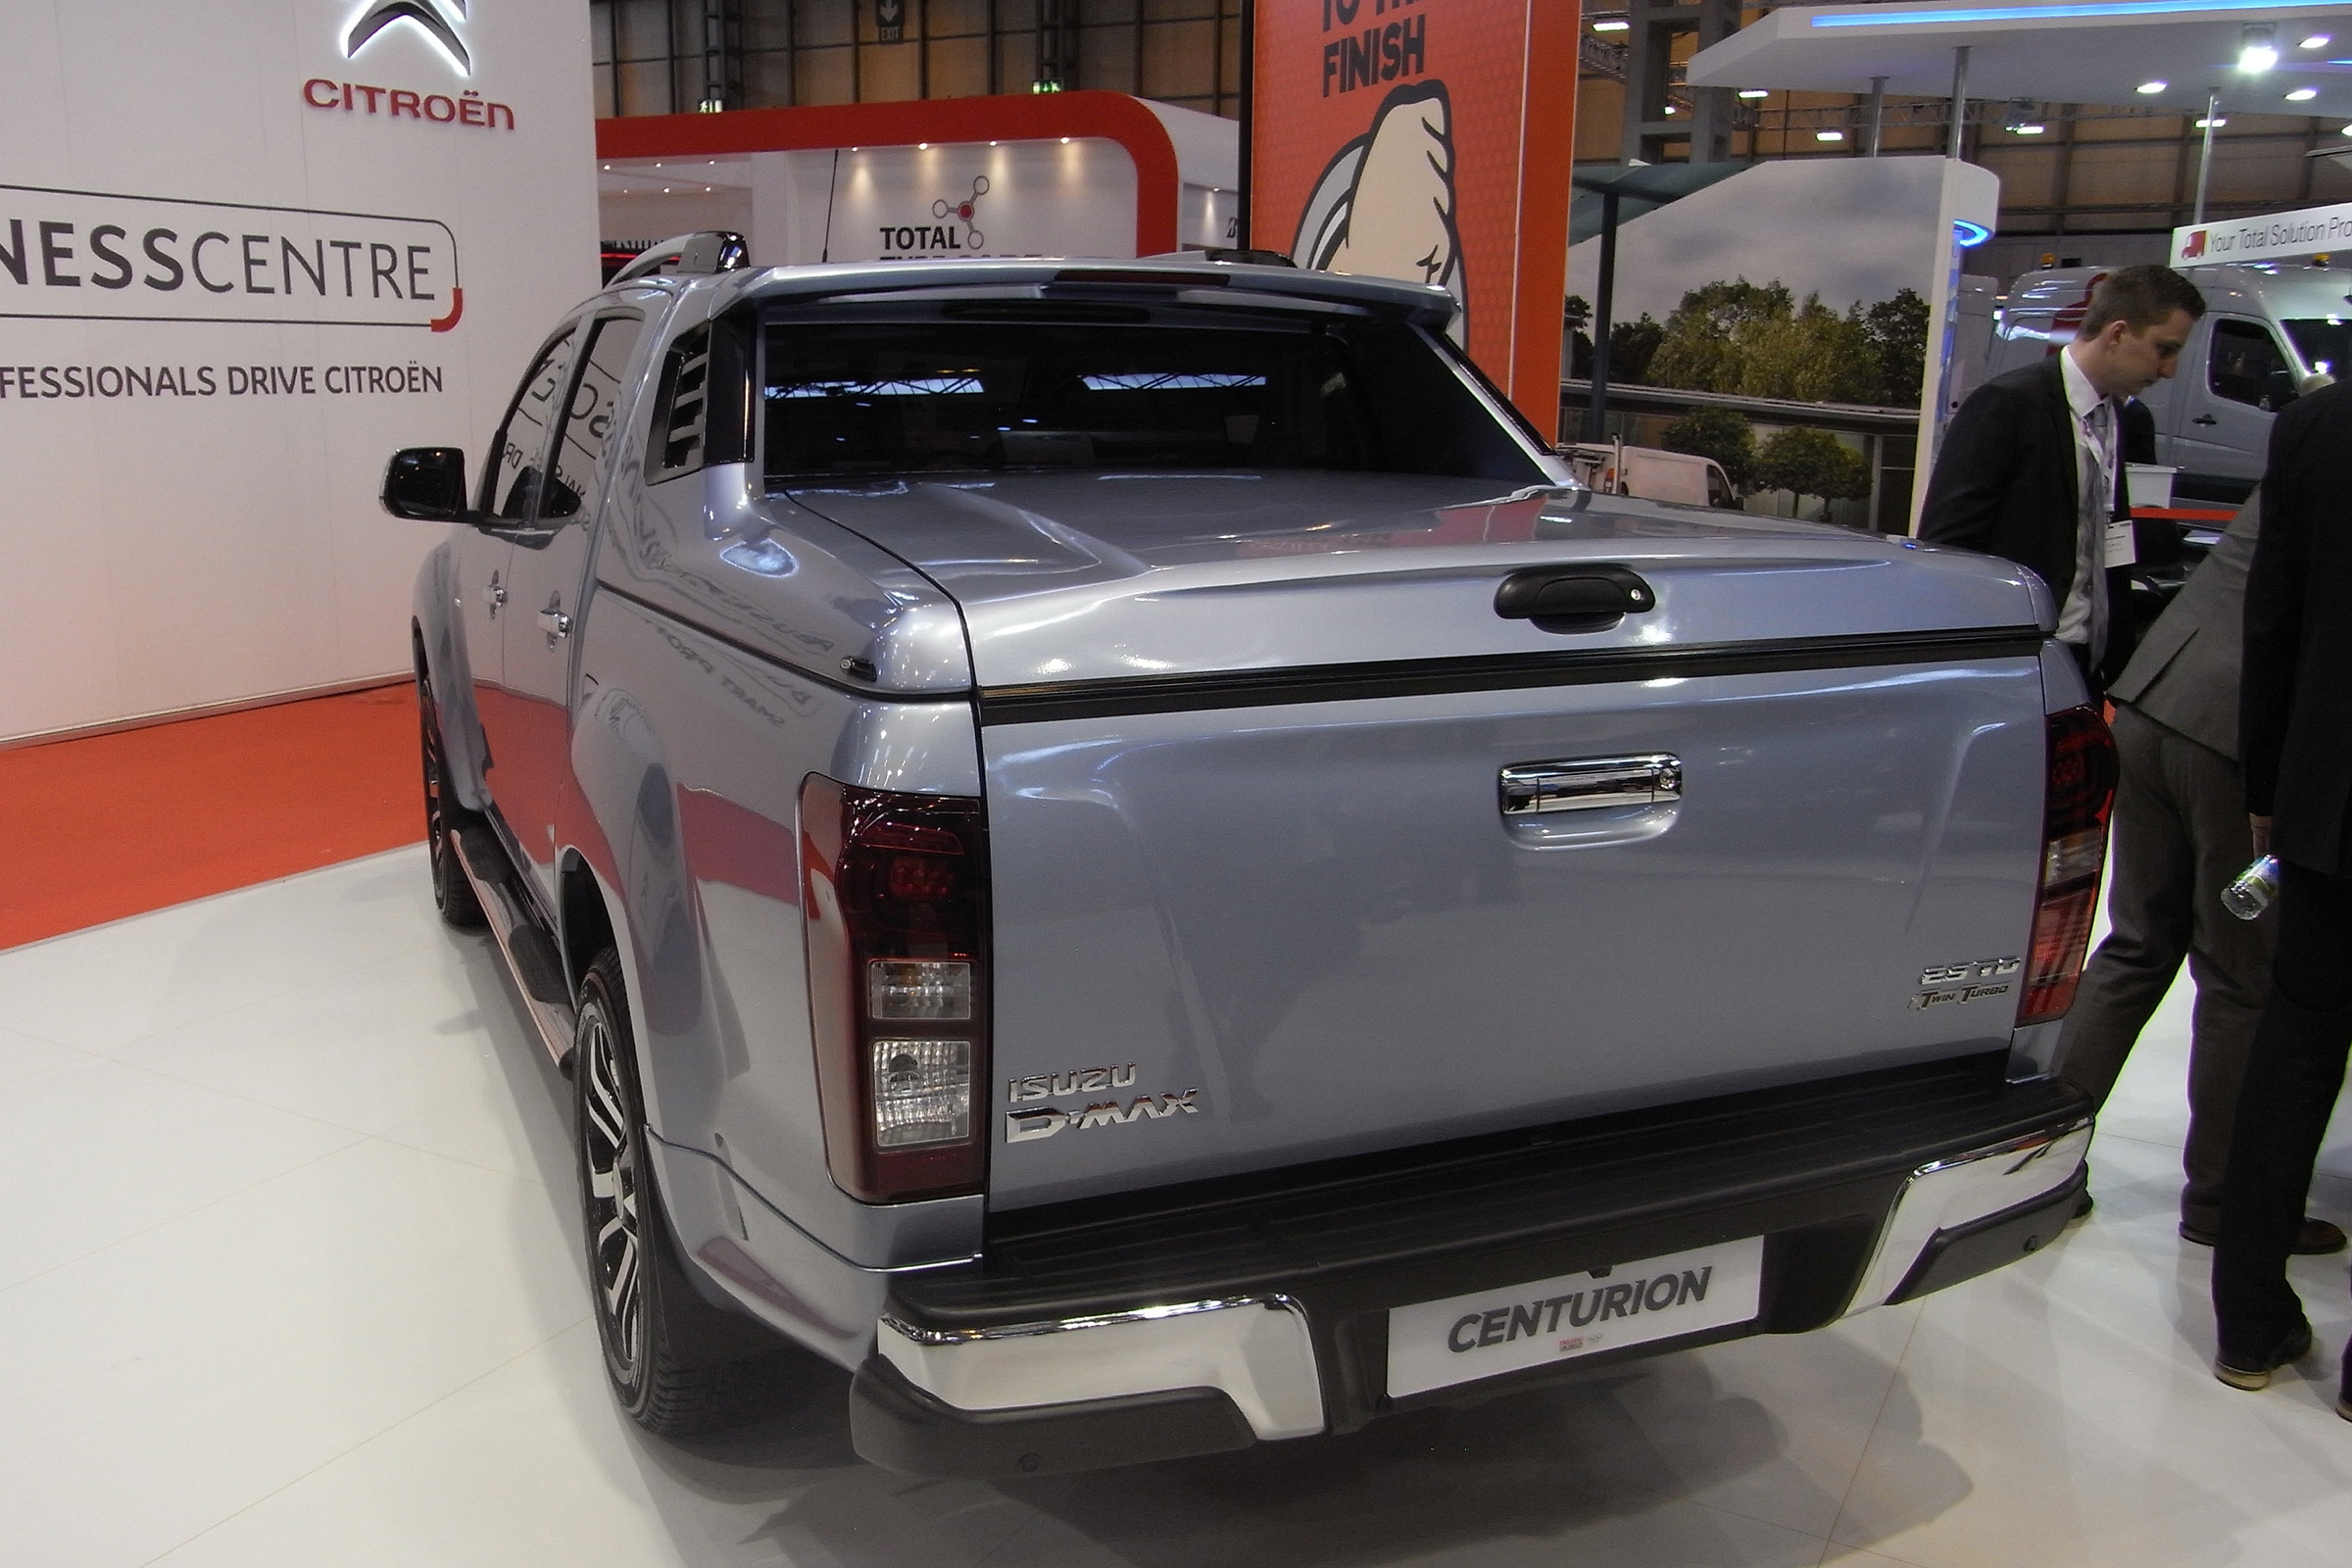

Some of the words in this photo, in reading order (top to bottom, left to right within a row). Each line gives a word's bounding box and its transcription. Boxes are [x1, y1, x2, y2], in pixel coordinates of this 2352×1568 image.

[1323, 14, 1425, 98] FINISH
[880, 226, 960, 251] TOTAL
[2209, 233, 2235, 253] Your
[2238, 227, 2268, 249] Total
[2270, 220, 2325, 246] Solution
[0, 366, 216, 398] FESSIONALS
[227, 366, 316, 395] DRIVE
[324, 361, 443, 394] CITROËN
[1008, 1061, 1136, 1102] ISUZU
[1005, 1088, 1199, 1144] D-MAX
[1447, 1265, 1712, 1353] CENTURION
